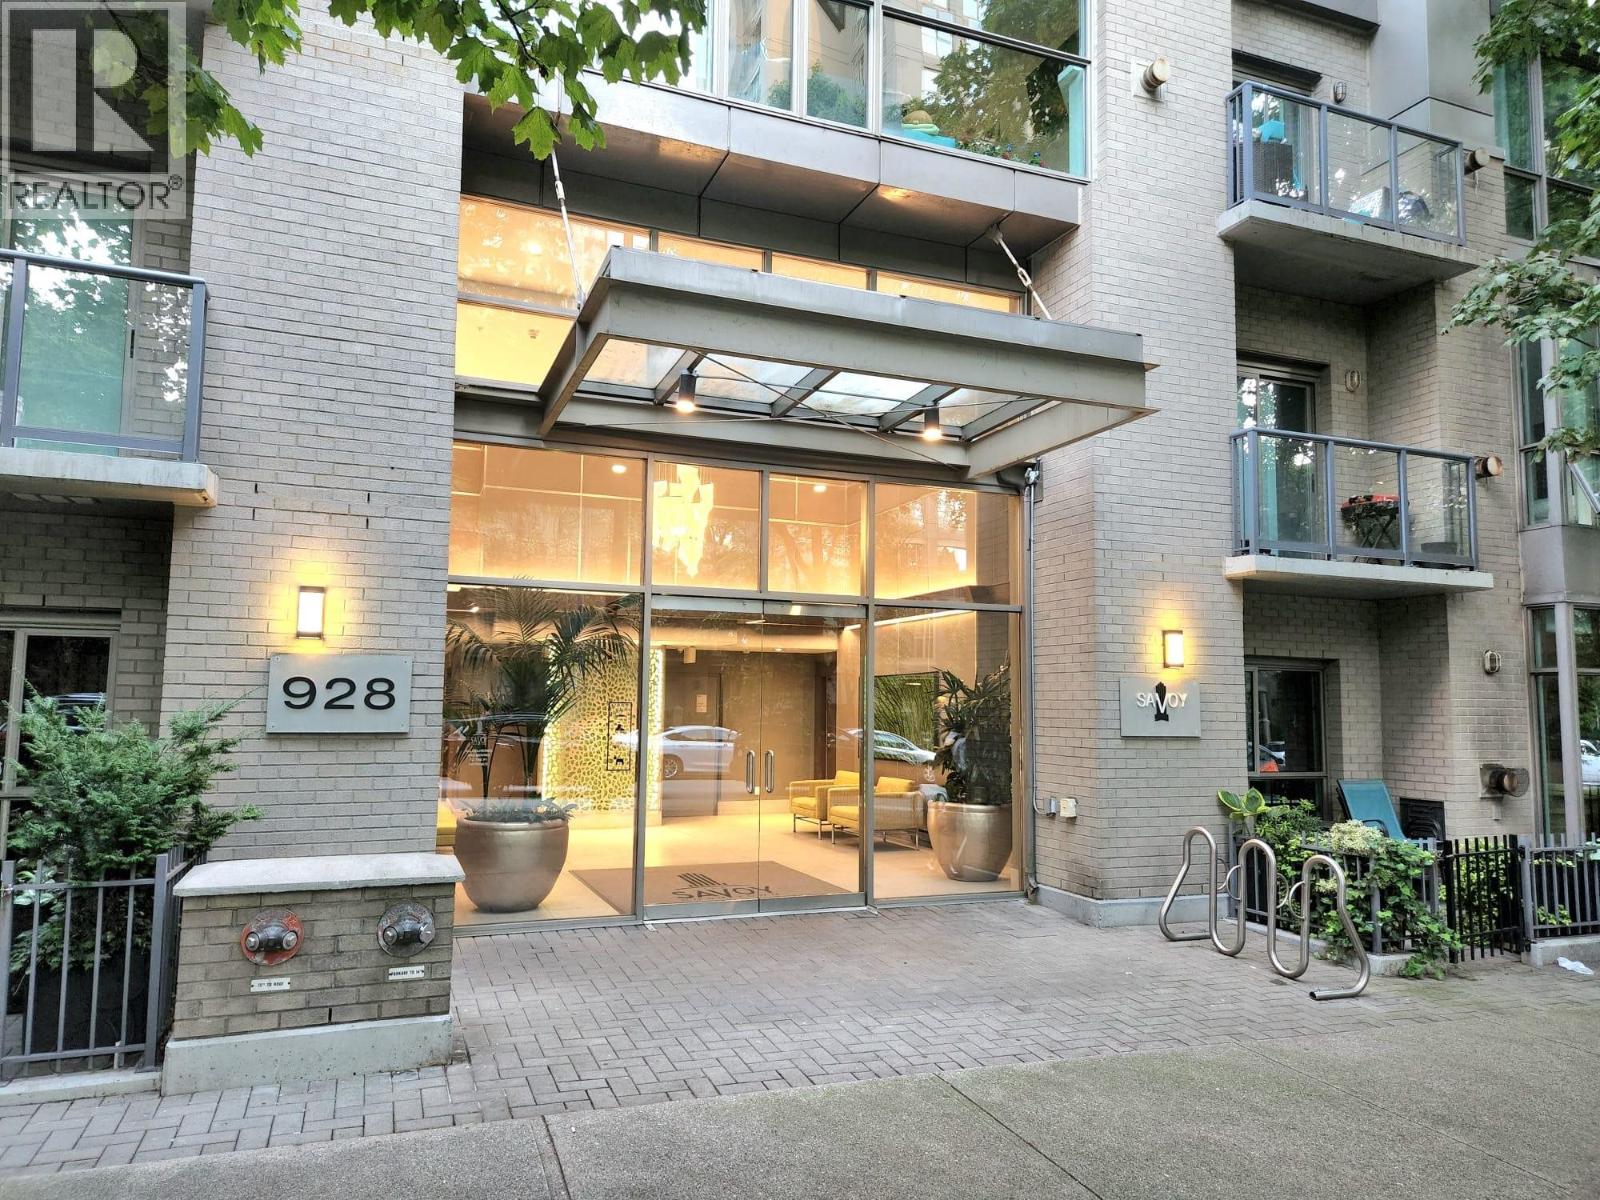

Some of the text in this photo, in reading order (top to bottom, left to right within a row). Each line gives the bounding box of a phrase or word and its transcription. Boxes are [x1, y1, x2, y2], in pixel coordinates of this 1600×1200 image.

[282, 676, 396, 710] 928
[1136, 692, 1188, 714] SAVOY
[671, 886, 772, 899] SAVOY
